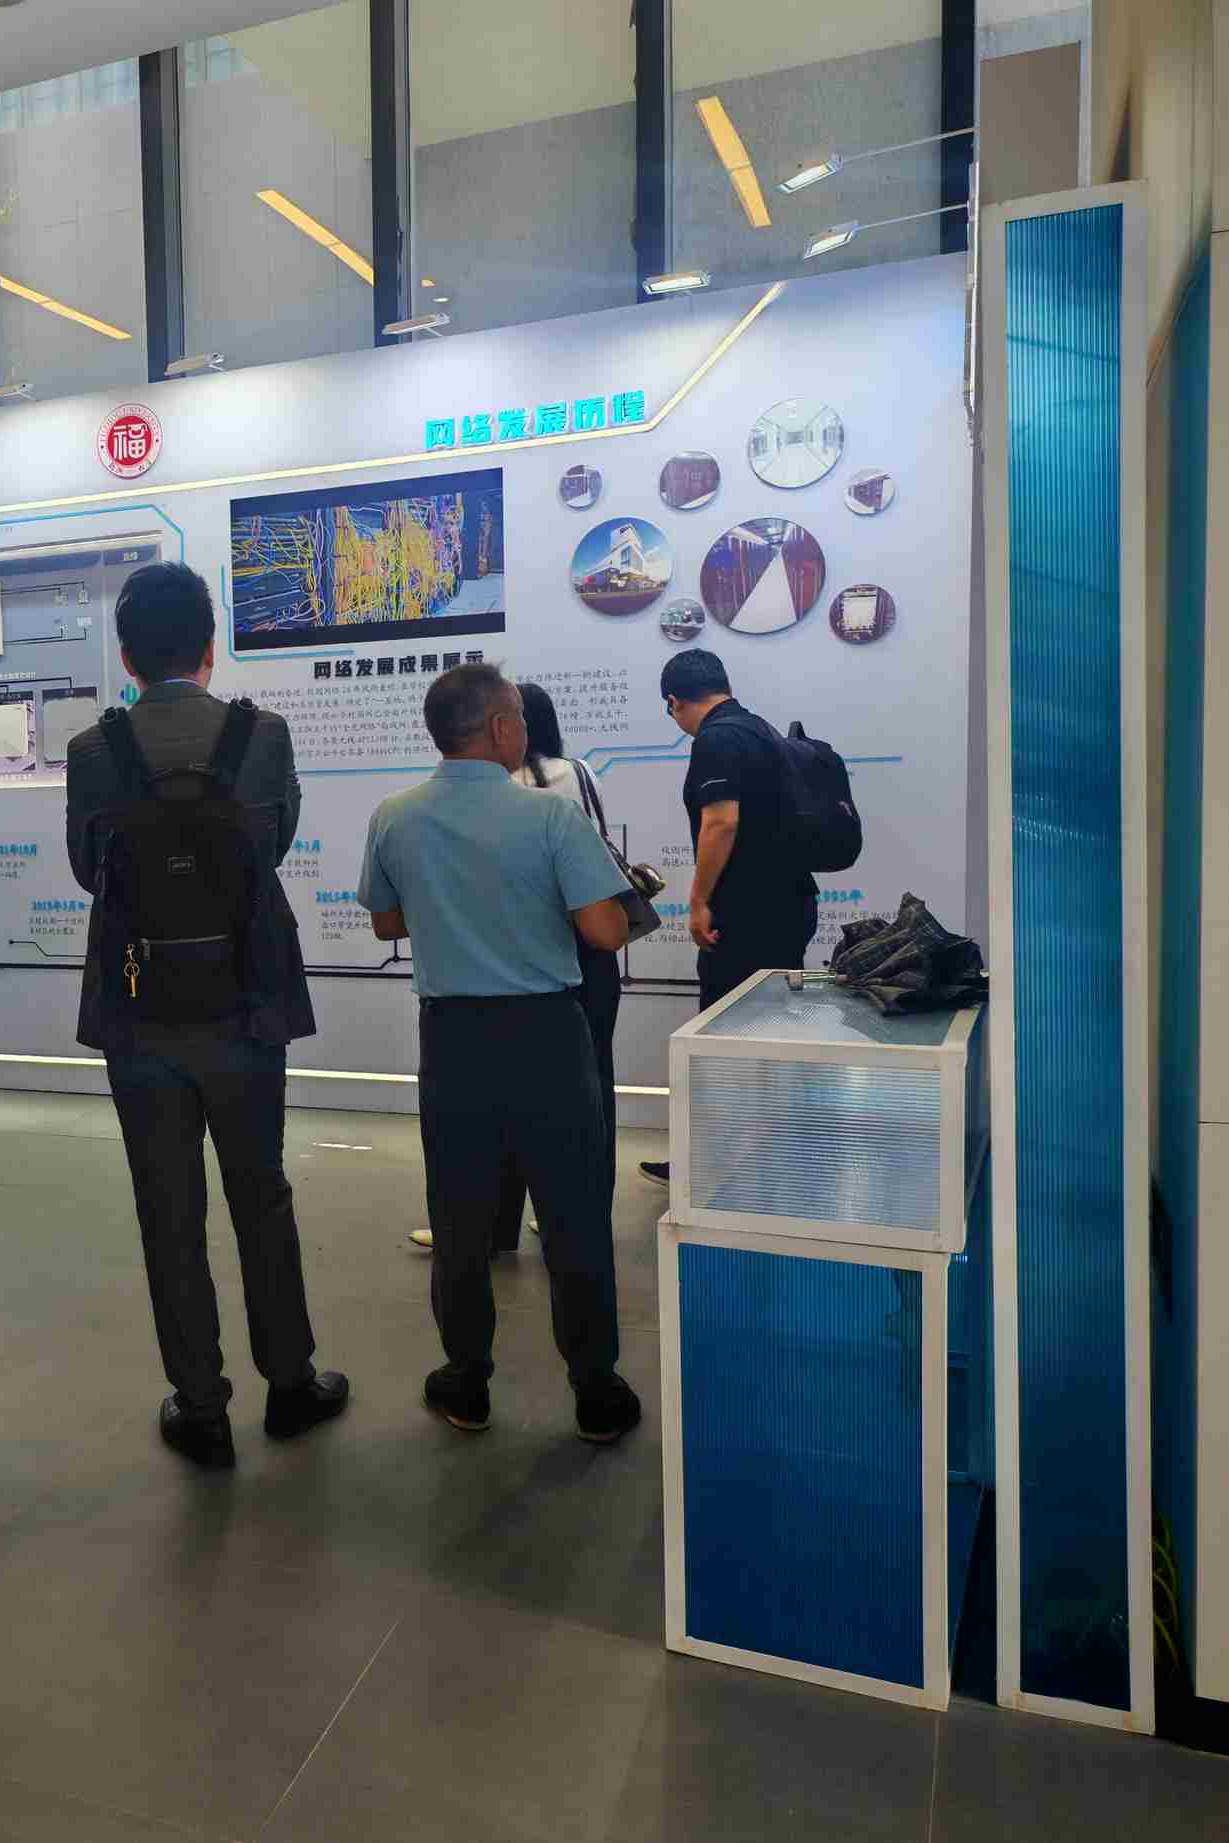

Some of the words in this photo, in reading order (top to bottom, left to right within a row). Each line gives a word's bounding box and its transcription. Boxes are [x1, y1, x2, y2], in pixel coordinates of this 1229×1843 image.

[425, 391, 645, 449] 网络发展历程
